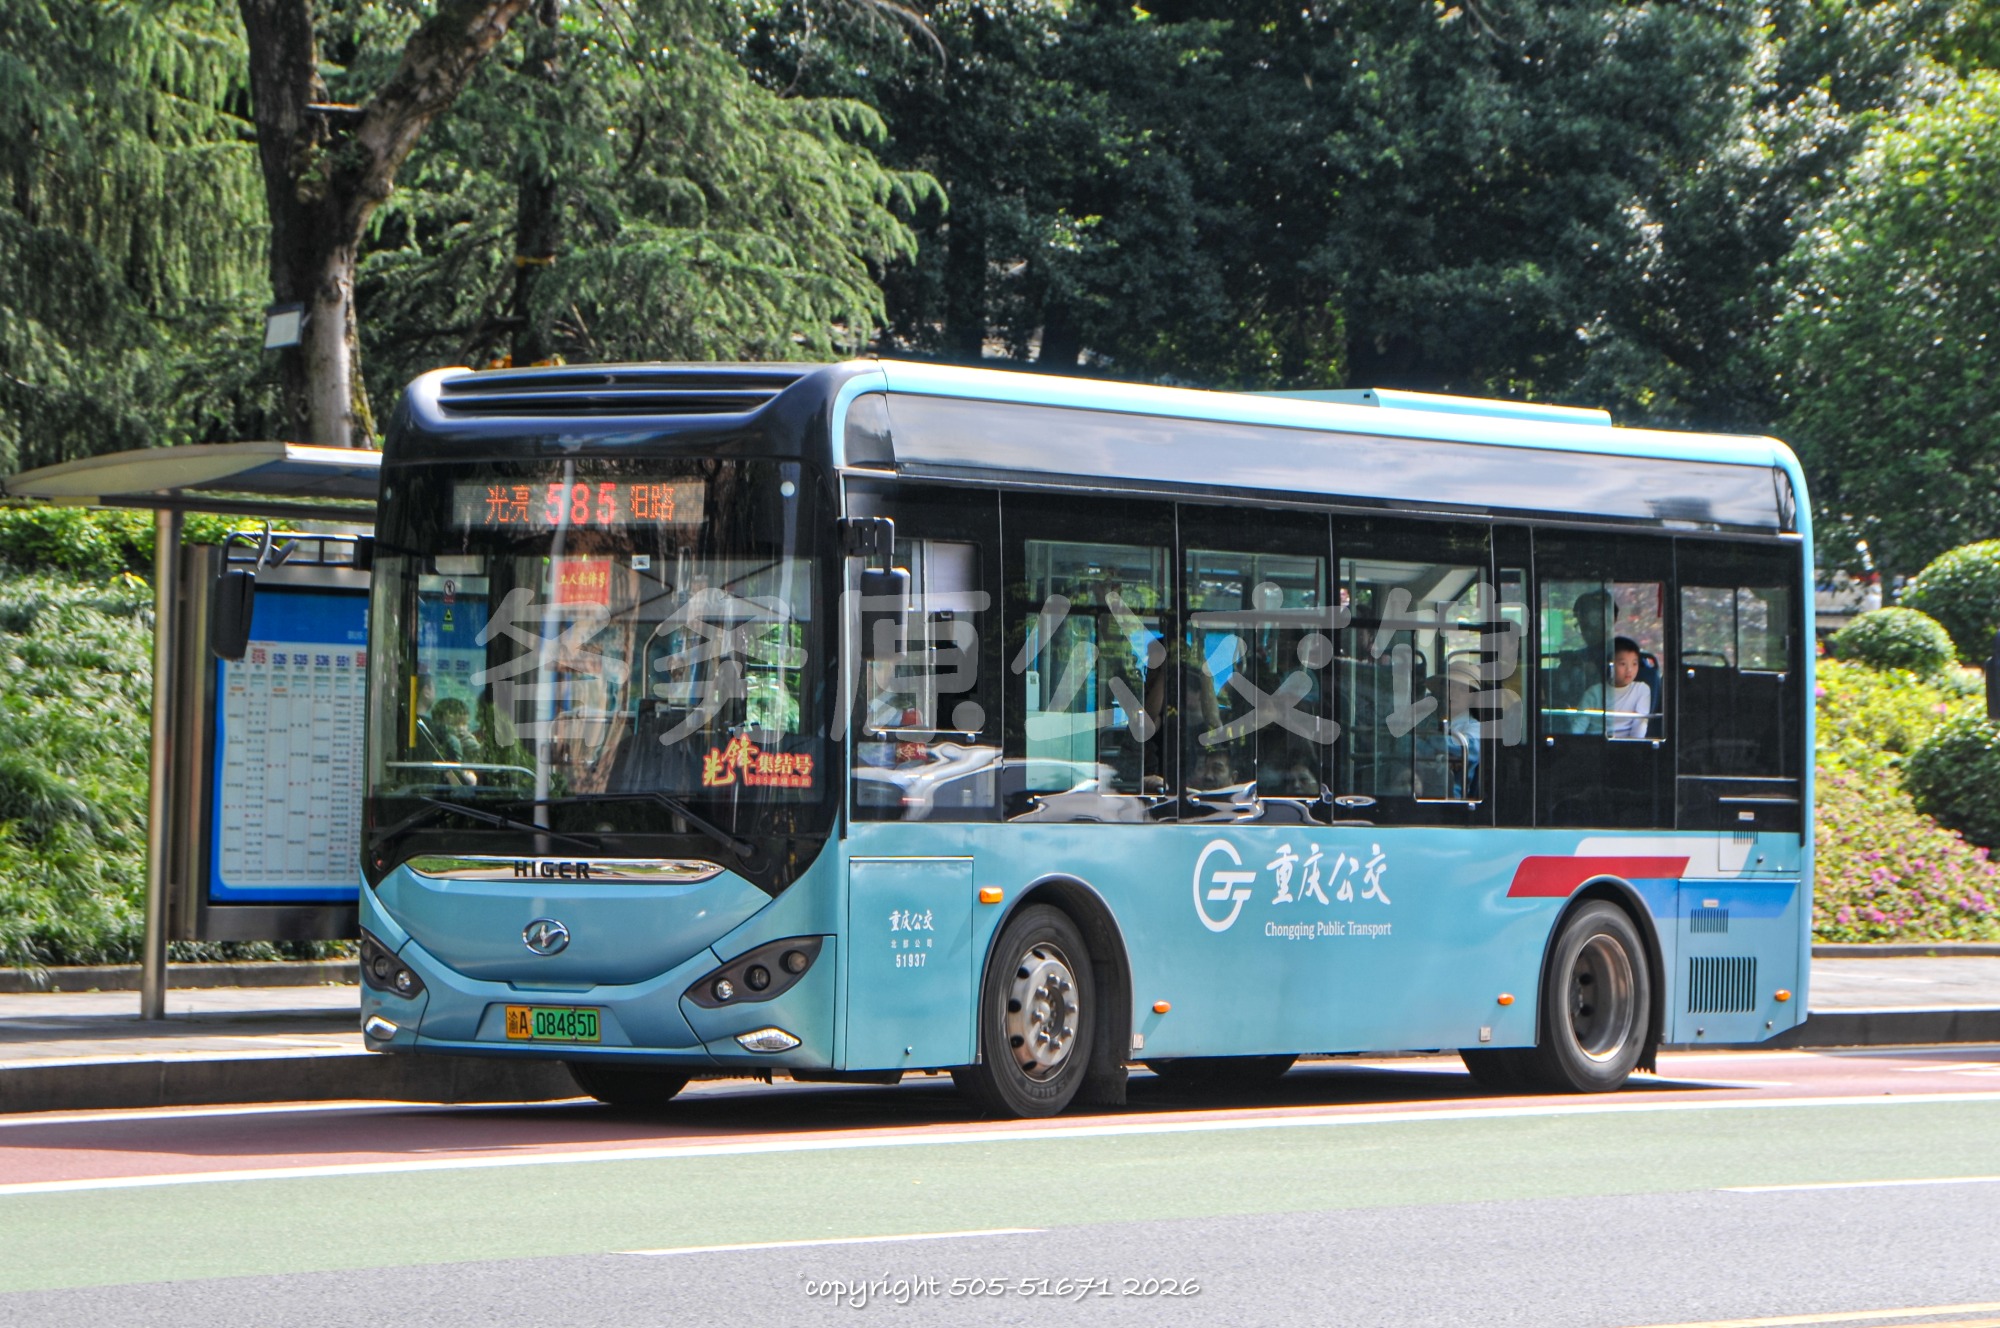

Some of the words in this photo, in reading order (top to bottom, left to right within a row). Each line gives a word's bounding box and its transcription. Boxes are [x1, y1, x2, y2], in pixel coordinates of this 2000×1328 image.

[545, 482, 617, 525] 585
[514, 860, 591, 879] HIGER
[1266, 843, 1392, 906] 重庆公交
[889, 909, 935, 932] 重庆公交
[1265, 921, 1316, 941] Chongqing
[1317, 920, 1346, 937] Public
[1348, 920, 1393, 940] Transport
